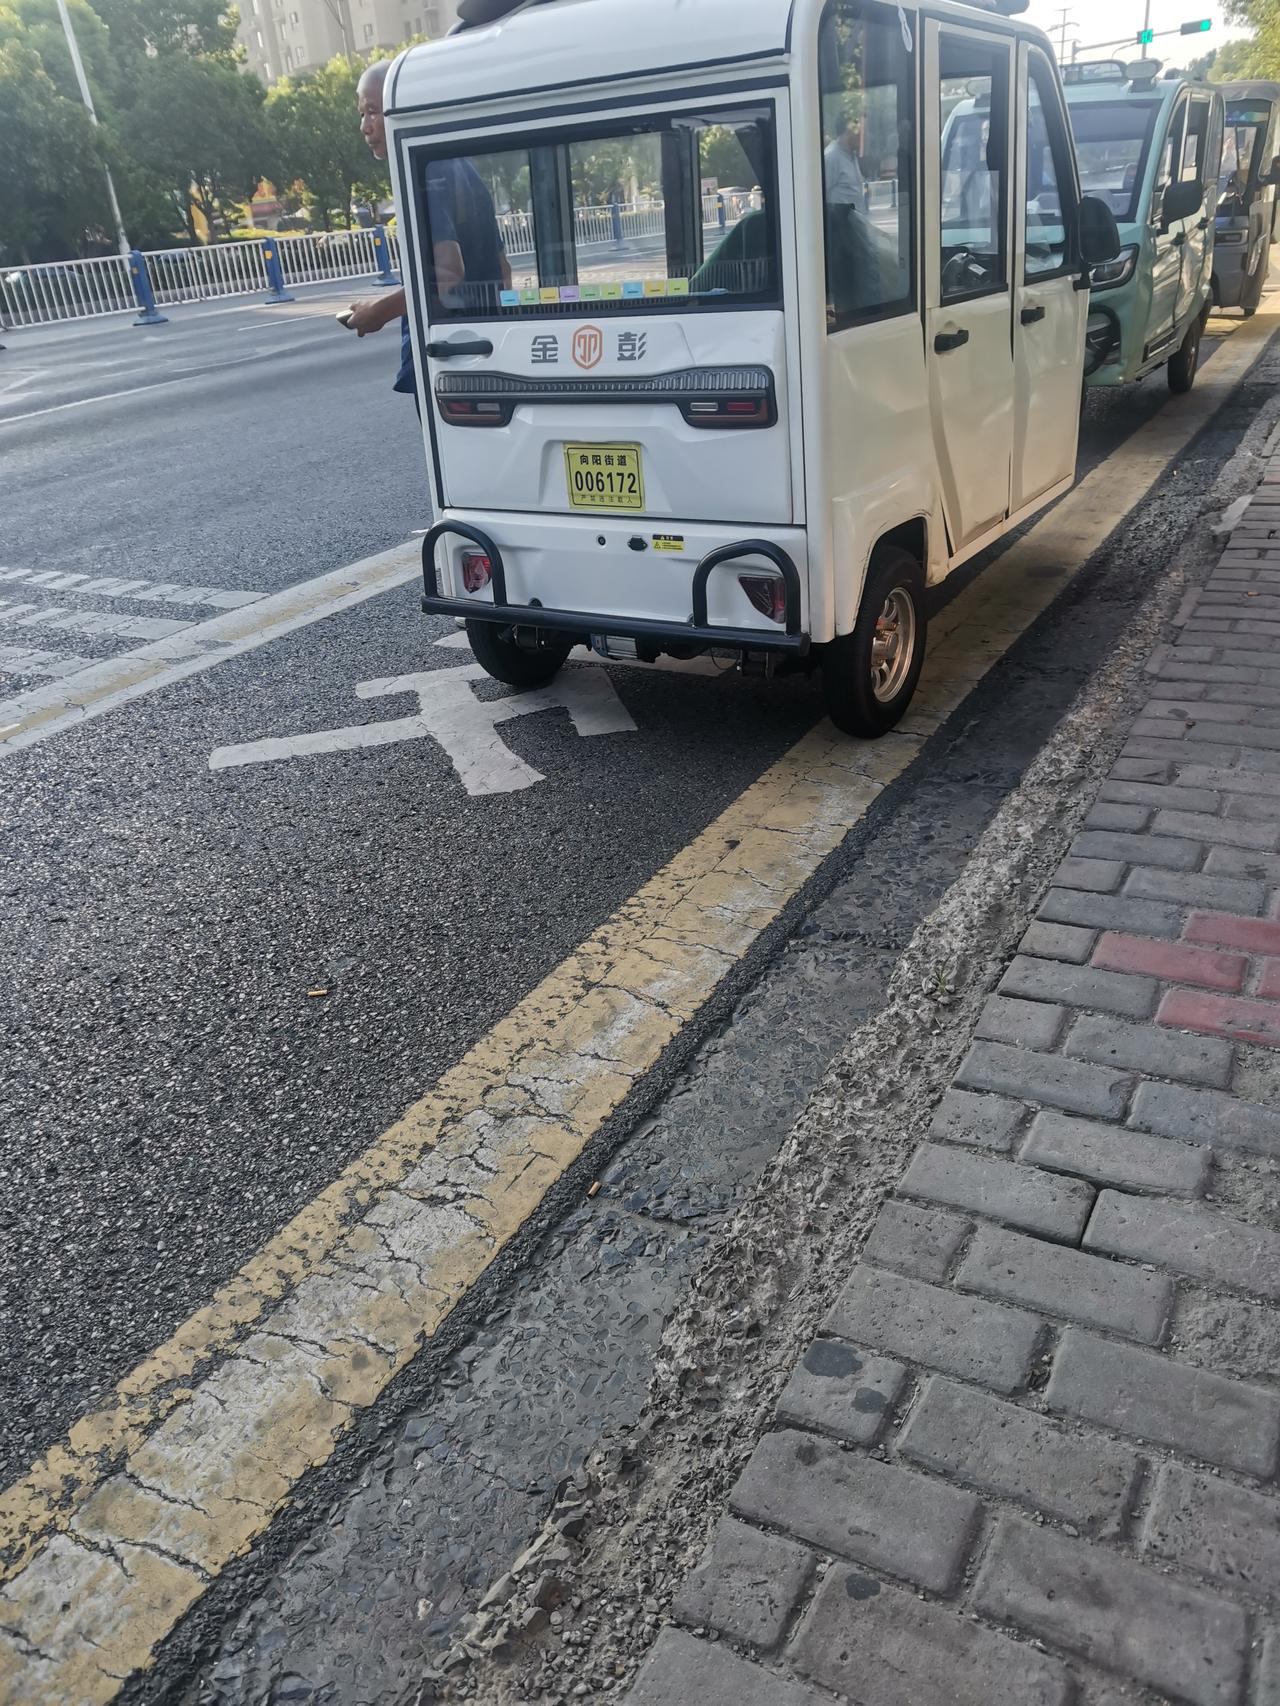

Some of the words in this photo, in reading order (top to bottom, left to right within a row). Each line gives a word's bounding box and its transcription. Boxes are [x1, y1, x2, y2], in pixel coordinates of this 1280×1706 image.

[531, 335, 558, 363] 金
[617, 332, 647, 361] 彭
[579, 454, 627, 466] 向阳街道
[575, 471, 637, 494] 006172
